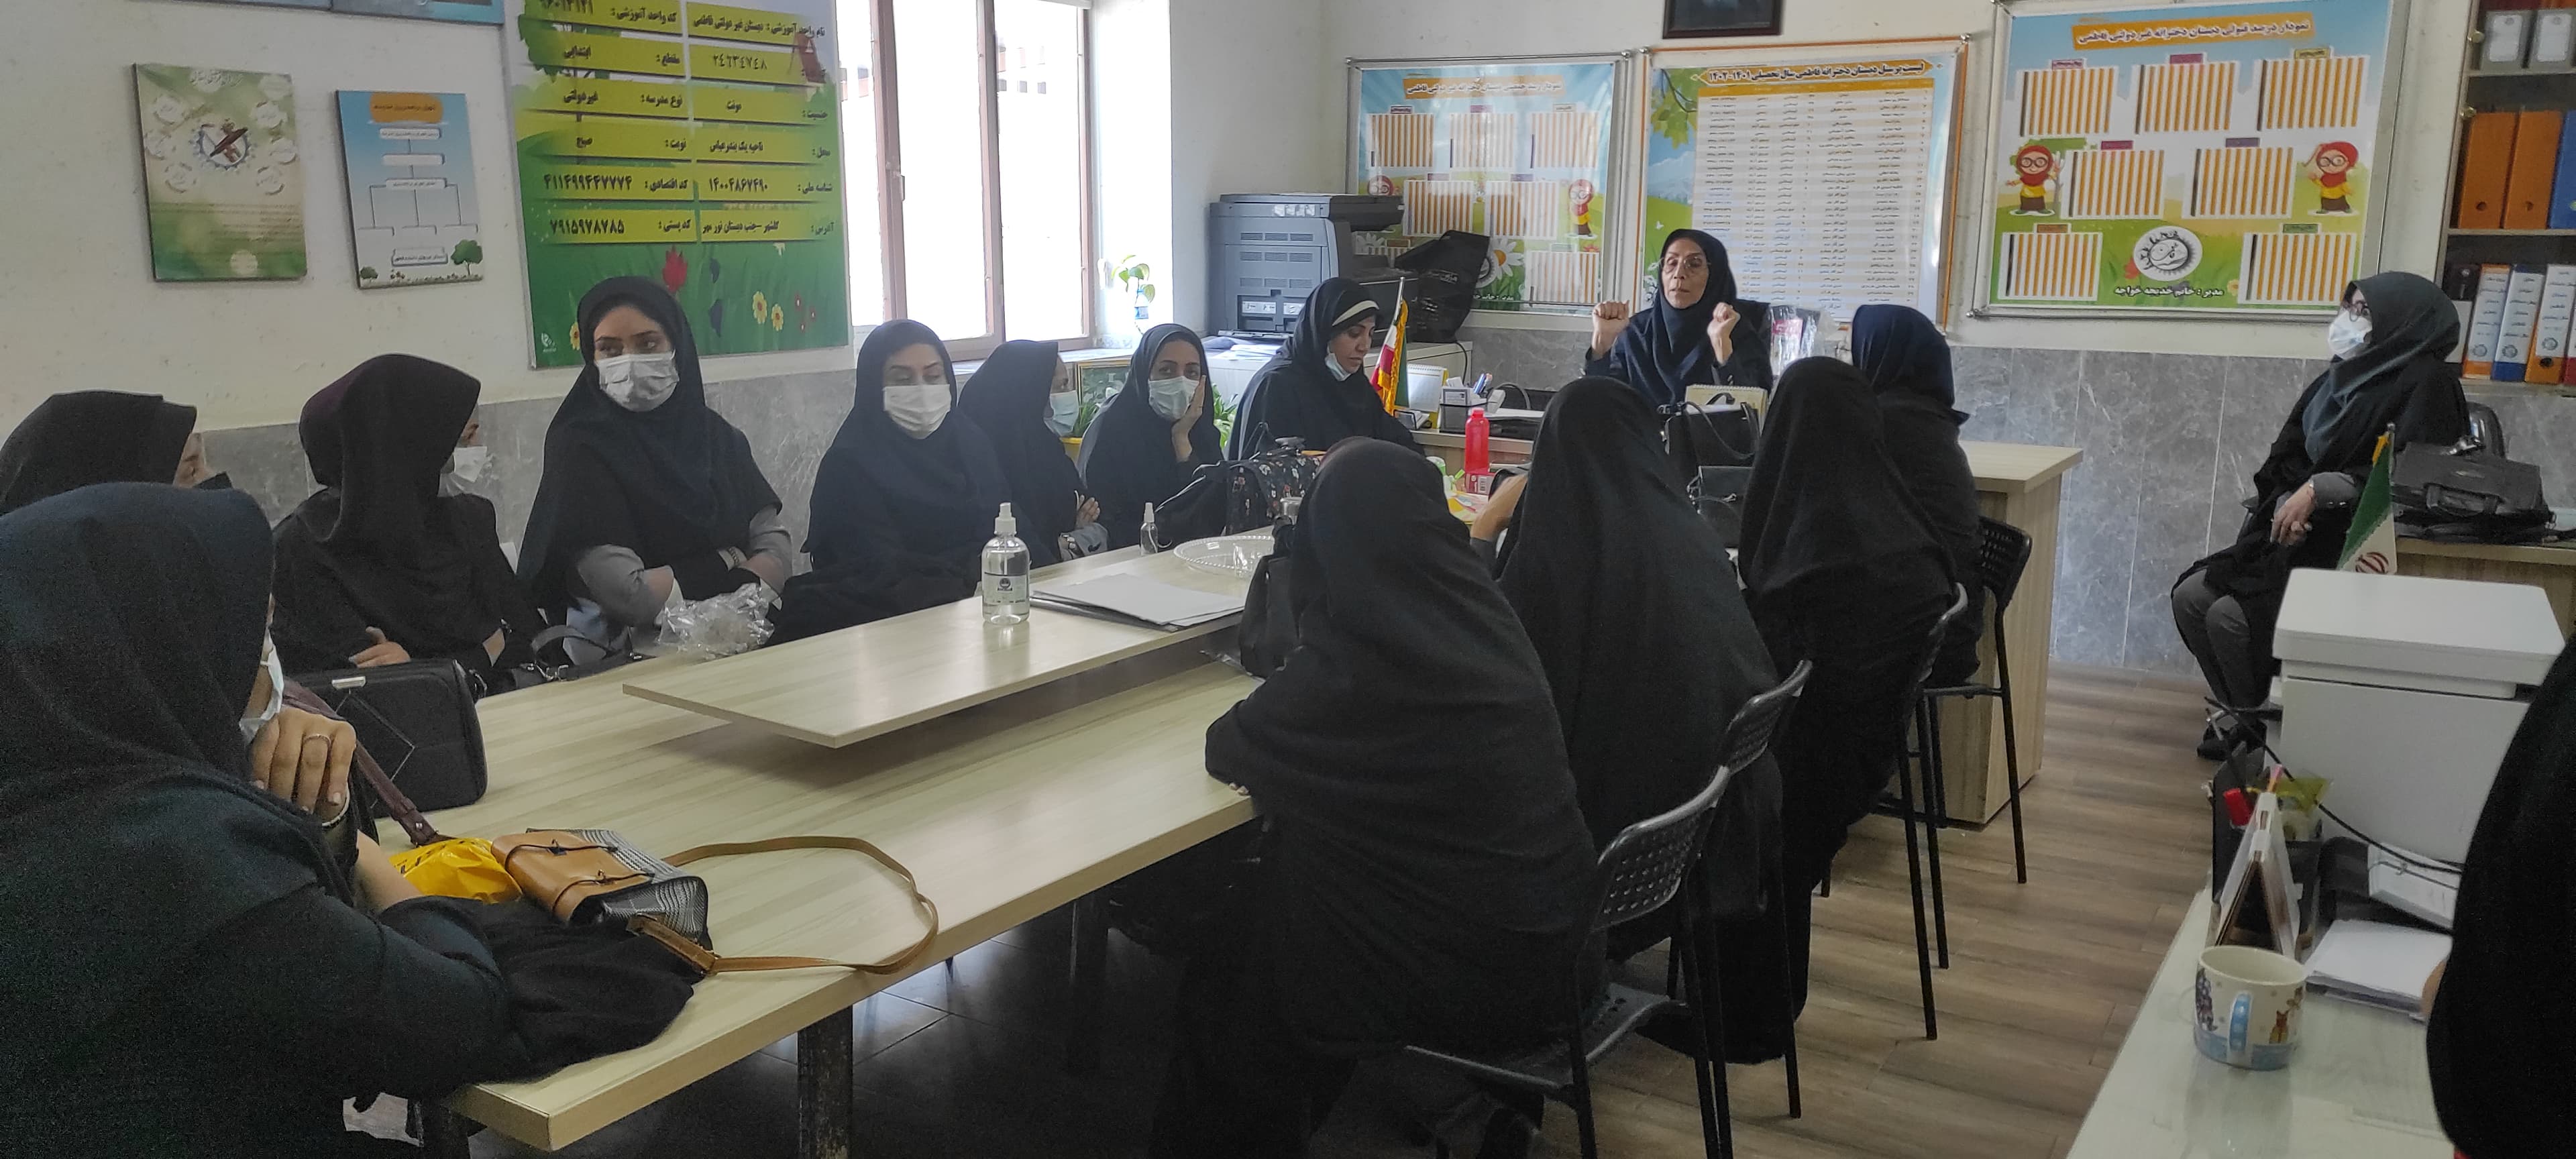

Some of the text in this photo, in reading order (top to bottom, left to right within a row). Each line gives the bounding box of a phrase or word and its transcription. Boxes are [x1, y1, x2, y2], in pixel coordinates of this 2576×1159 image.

[616, 7, 646, 21] آموزشی
[648, 11, 666, 24] واحد
[667, 12, 677, 23] کد
[694, 14, 714, 27] فاطمی
[2279, 20, 2310, 33] نمودار
[771, 23, 797, 36] آموزشی
[799, 25, 815, 39] واحد
[816, 27, 826, 38] نام
[2154, 27, 2186, 39] دخترانه
[2189, 26, 2220, 38] دبستان
[2222, 23, 2247, 35] قبولی
[2250, 23, 2276, 34] درصد
[2079, 30, 2107, 43] فاطمی
[661, 52, 680, 66] مقطع
[1752, 69, 1779, 80] تحصیلی
[1780, 68, 1794, 79] سال
[1796, 66, 1820, 78] فاطمی
[1822, 66, 1850, 78] دخترانه
[1851, 64, 1877, 76] دبستان
[1878, 64, 1902, 75] پرسنل
[1902, 63, 1924, 74] لیست
[1408, 83, 1427, 94] فاطمی
[646, 95, 669, 107] مدرسه
[671, 94, 683, 108] نوع
[806, 111, 828, 120] جنسیت
[576, 137, 593, 148] صبح
[671, 138, 687, 151] نوبت
[739, 141, 748, 153] یک
[749, 142, 763, 154] ناحیه
[817, 147, 831, 158] محل
[649, 178, 678, 192] اقتصادی
[679, 179, 688, 189] کد
[802, 182, 814, 194] ملی
[816, 182, 833, 192] شناسه
[682, 219, 692, 229] کد
[713, 221, 722, 234] نور
[724, 220, 743, 233] دبستان
[814, 222, 835, 235] آدرس
[2114, 285, 2141, 296] خواجه
[2144, 286, 2173, 296] خدیجه
[2174, 287, 2195, 298] خانم
[2203, 288, 2224, 298] مدیر
